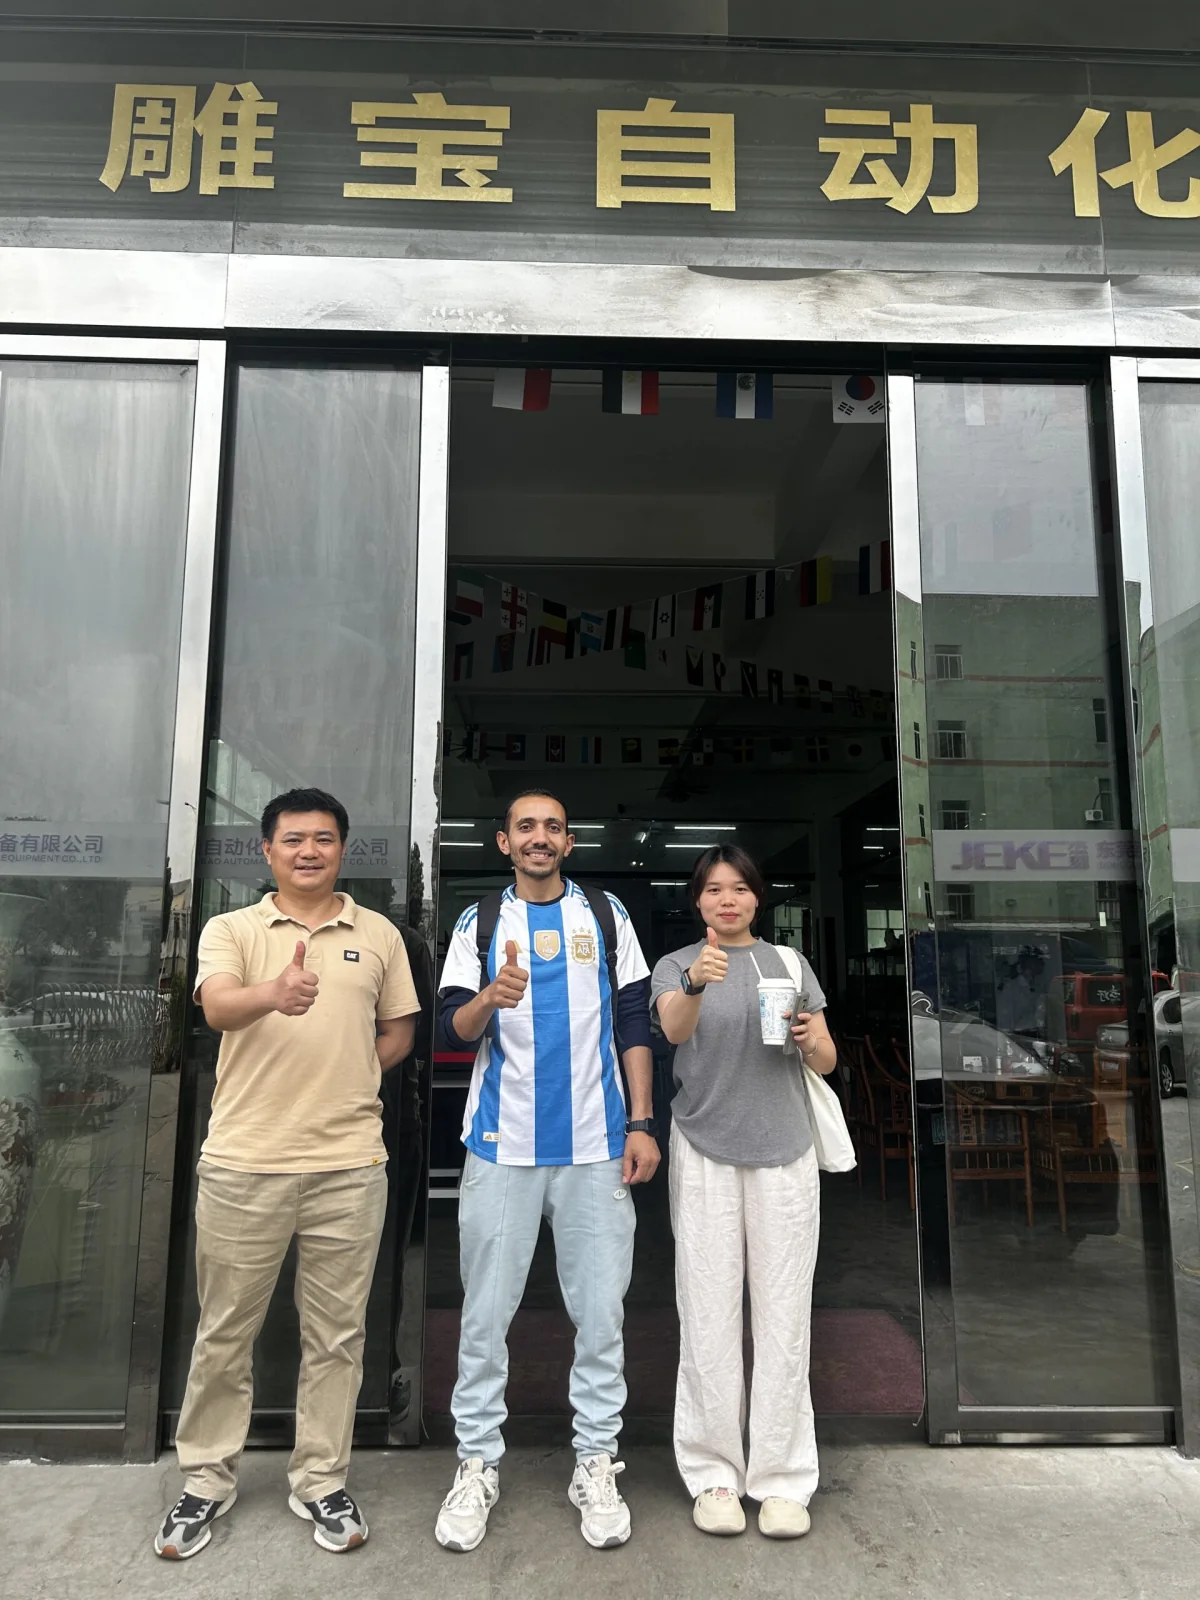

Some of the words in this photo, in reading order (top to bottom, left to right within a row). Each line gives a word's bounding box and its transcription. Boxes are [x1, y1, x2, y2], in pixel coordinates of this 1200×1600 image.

[0, 833, 104, 853] 备有限公司
[346, 838, 388, 856] 公司
[2, 854, 60, 863] EQUIPMENT
[224, 857, 268, 865] AUTOMA
[951, 840, 1069, 871] JEKE
[346, 952, 358, 960] CAT
